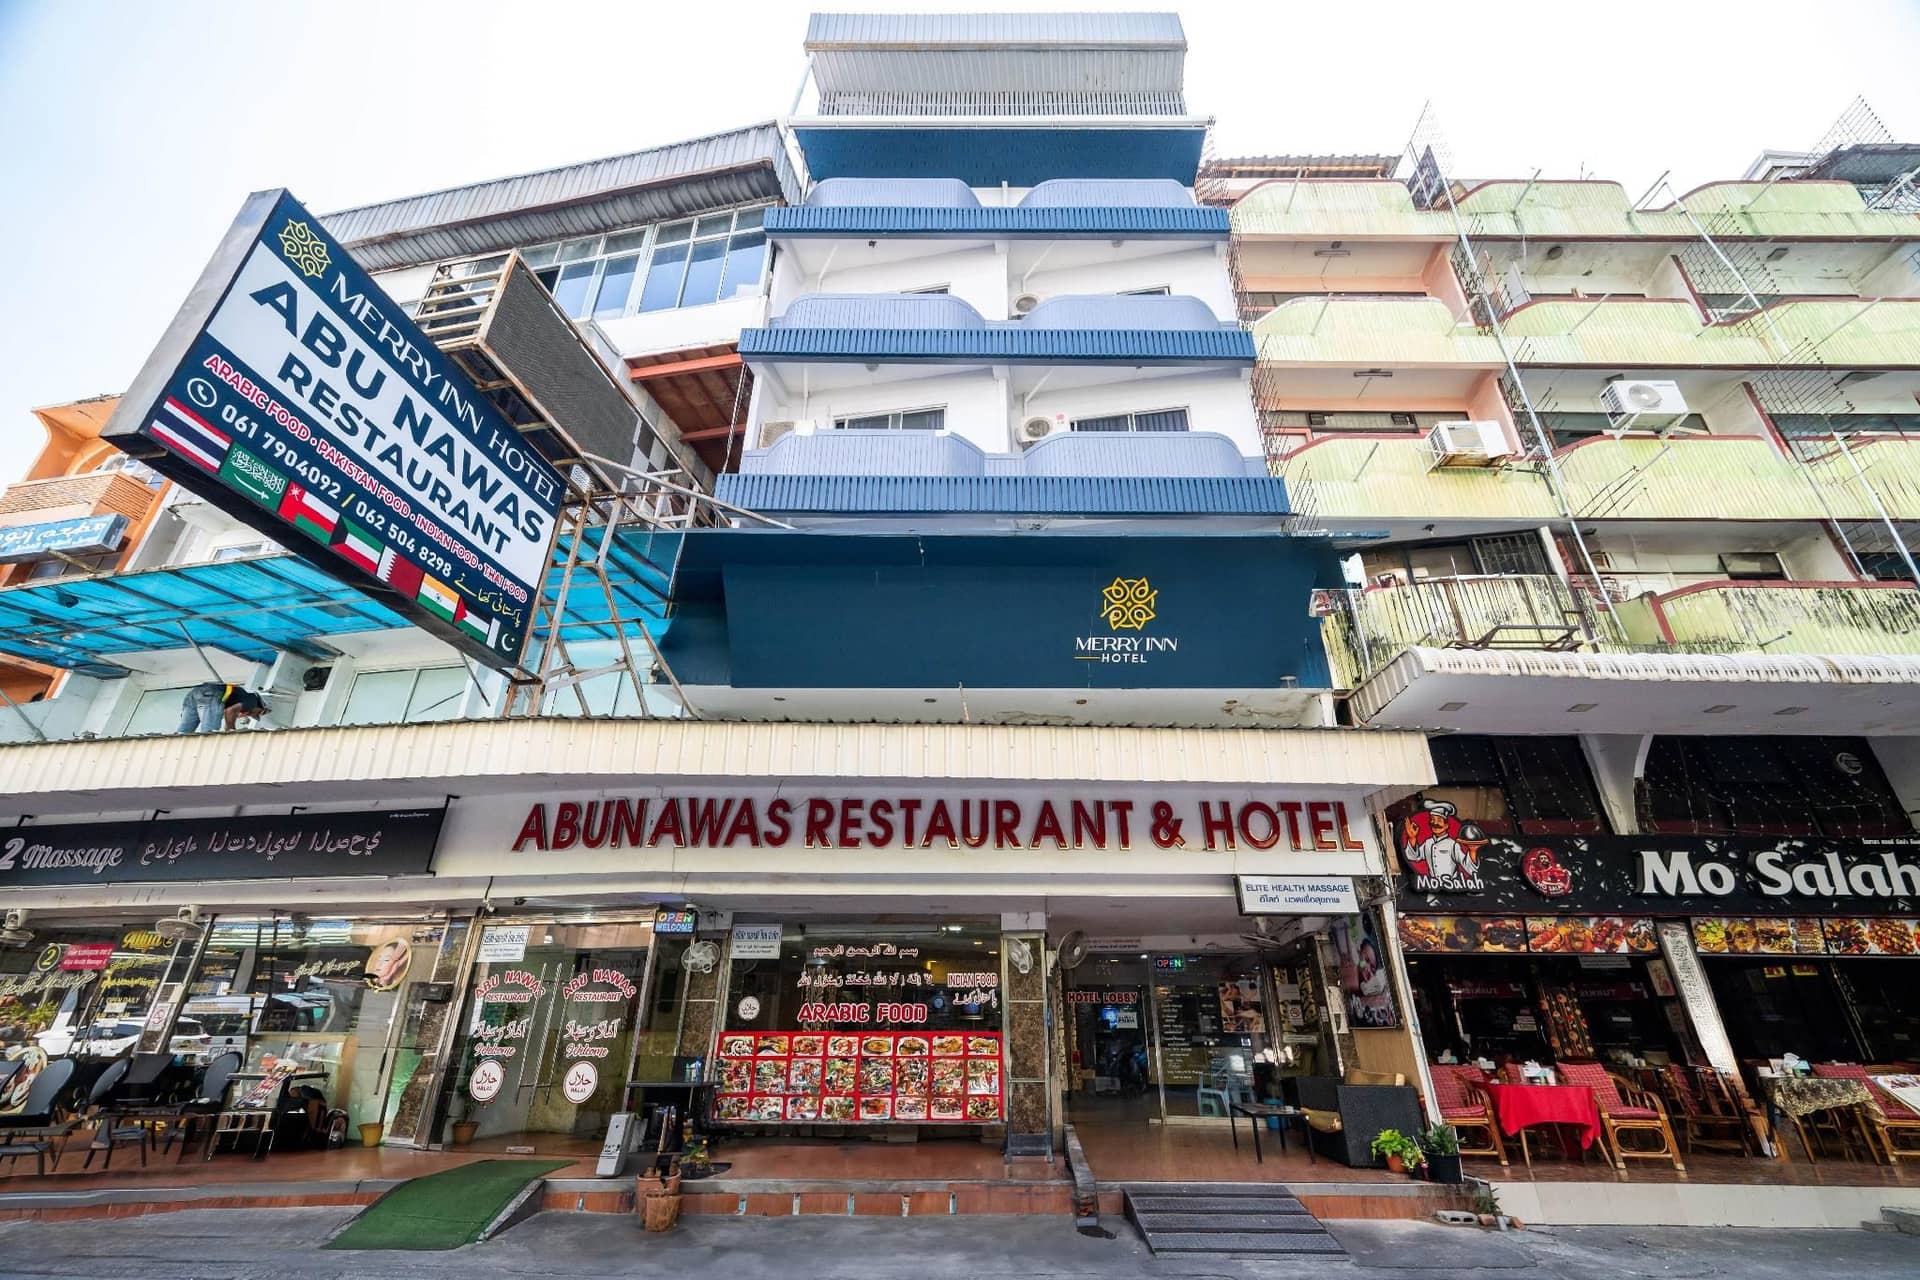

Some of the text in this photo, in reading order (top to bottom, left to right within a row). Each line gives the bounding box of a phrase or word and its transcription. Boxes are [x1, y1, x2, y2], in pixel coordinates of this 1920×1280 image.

[204, 354, 310, 441] ARABIC FOOD
[331, 272, 560, 505] MERRY INN HOTEL
[249, 281, 545, 544] ABU NAWAS
[277, 352, 511, 554] RESTAURANT
[317, 438, 378, 495] PAKISTAN
[377, 487, 410, 517] FOOD
[221, 404, 259, 439] 061
[262, 432, 342, 499] 7904092
[356, 501, 386, 530] 062
[388, 523, 416, 553] 504
[418, 546, 452, 577] 8298
[415, 513, 479, 569] INDIAN FOOD
[483, 562, 528, 604] THAI FOOD
[1075, 637, 1178, 652] MERRY INN
[1101, 653, 1148, 663] HOTEL
[511, 798, 1365, 852] ABUNAWAS RESTAURANT & HOTEL
[0, 837, 123, 875] 2 Massage
[1417, 872, 1485, 890] Mo Salah
[1639, 850, 1920, 897] Mo Salah
[1246, 884, 1350, 893] ELITE HEALTH MASSAGE
[658, 912, 694, 922] OPEN
[655, 922, 694, 933] WELCOME
[1155, 958, 1182, 968] OPEN
[474, 973, 500, 999] ABU
[562, 968, 637, 999] ABU NAWAS
[947, 972, 998, 988] INDIAN FOOD
[485, 992, 533, 1002] RESTAURANT
[573, 991, 624, 1002] RESTAURANT
[1068, 991, 1138, 1004] HOTEL LOBBY
[797, 1003, 928, 1023] ARABIC FOOD
[475, 1069, 498, 1085] حلال
[568, 1070, 592, 1086] حلال
